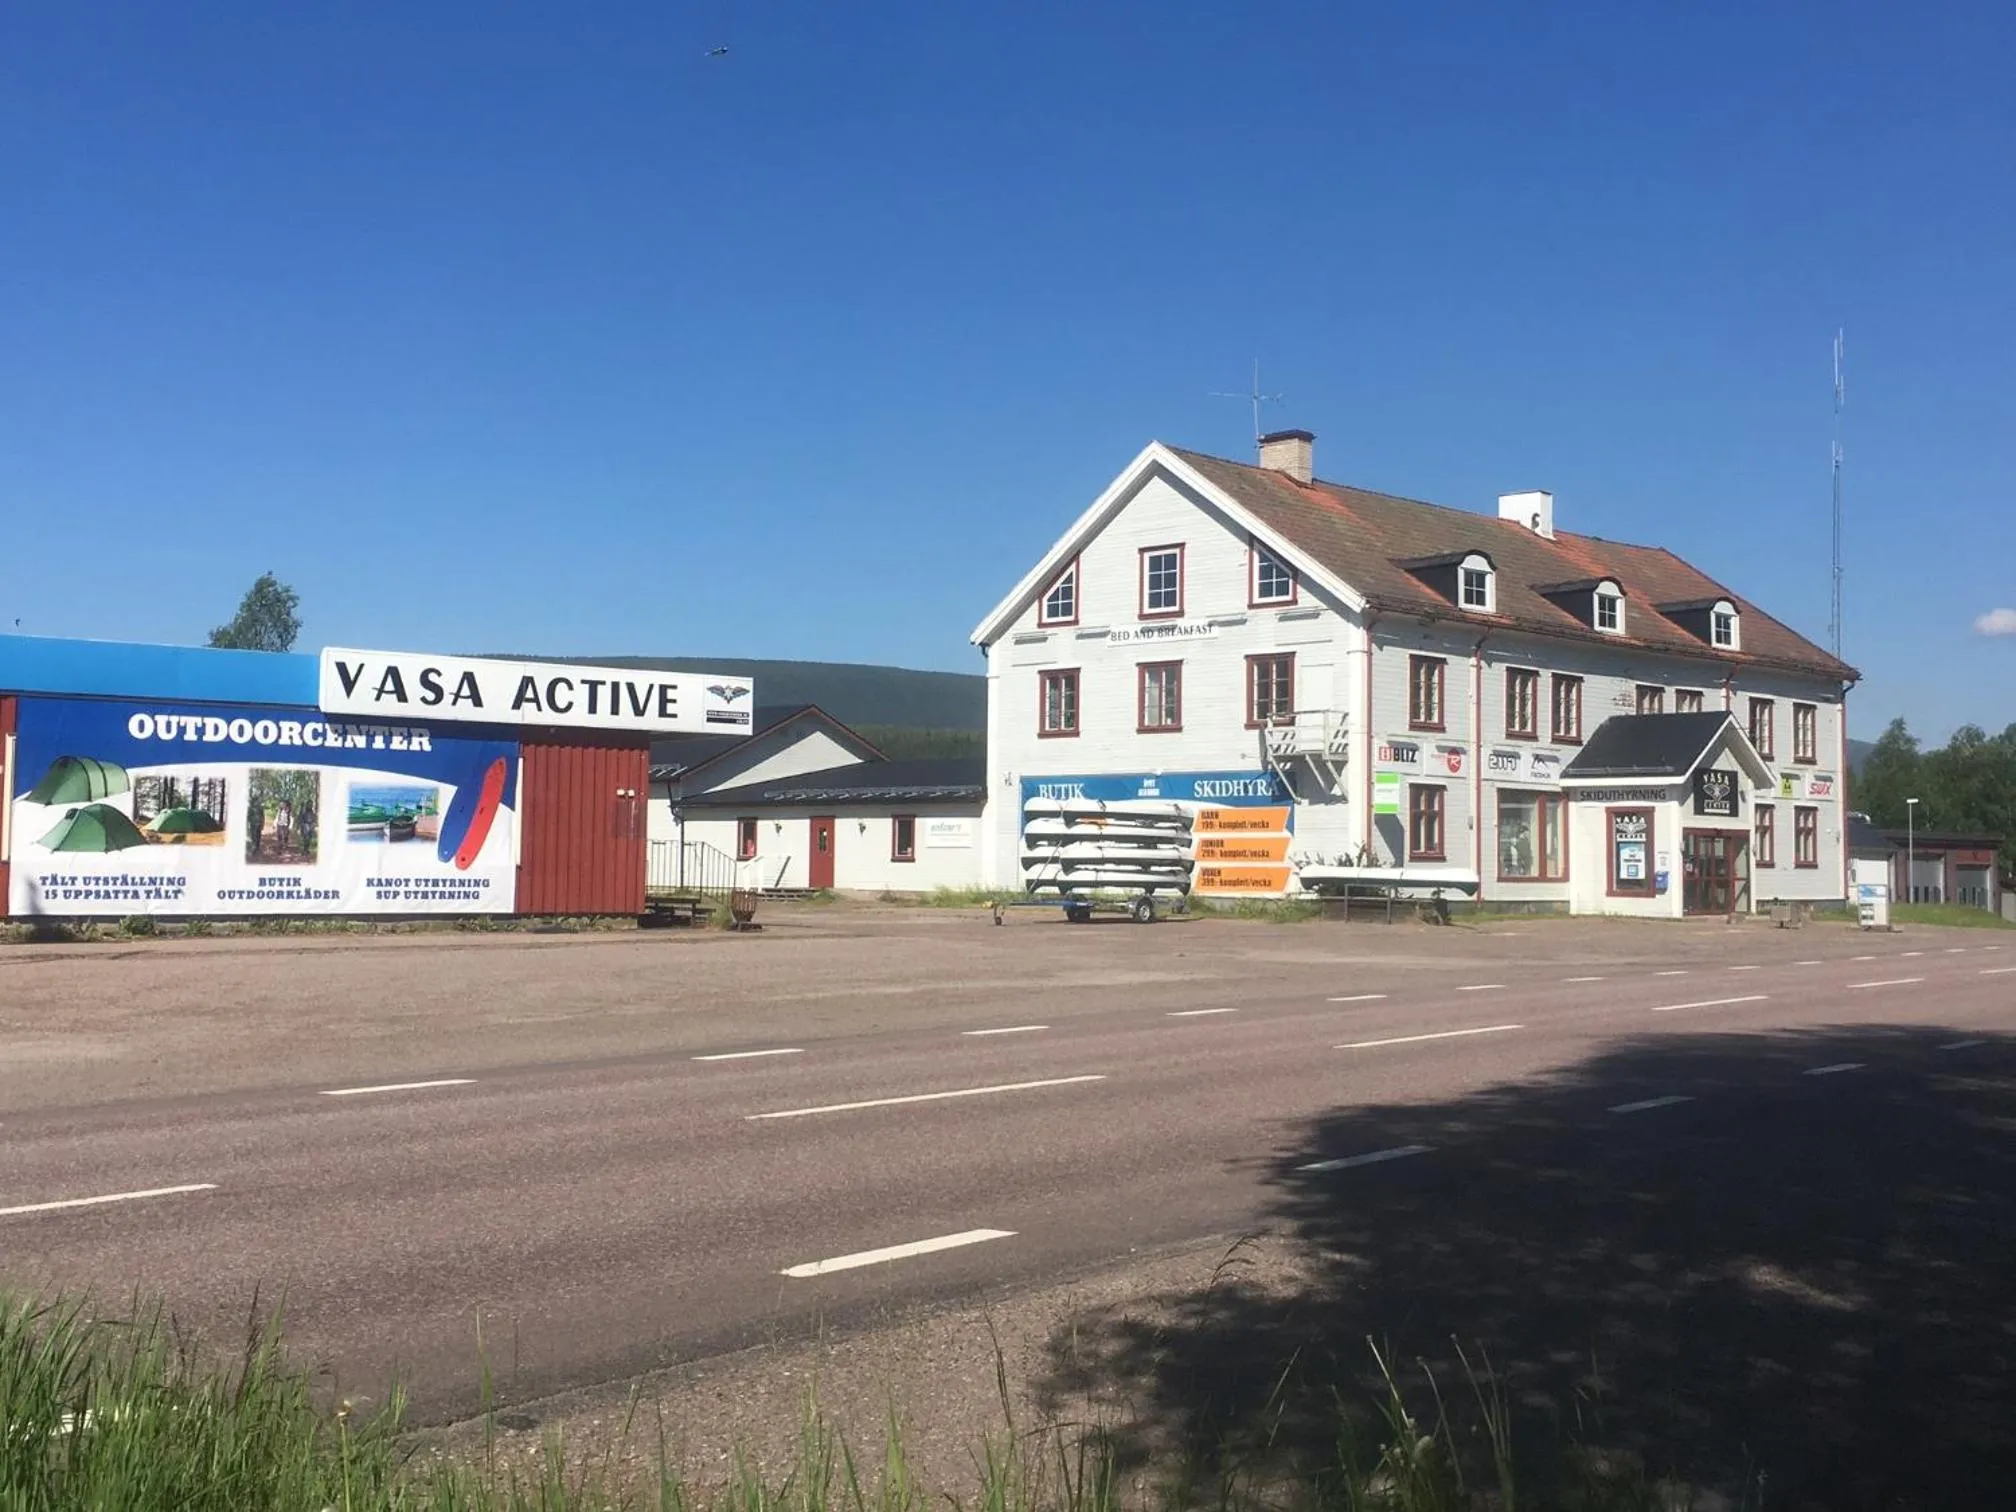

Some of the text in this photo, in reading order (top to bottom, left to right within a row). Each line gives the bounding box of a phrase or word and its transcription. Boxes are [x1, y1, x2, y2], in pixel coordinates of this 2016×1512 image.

[1110, 624, 1214, 641] BED AND BREAKFAST
[335, 661, 679, 719] VASA ACTIVE
[128, 713, 432, 752] OUTDOORCENTER
[1393, 747, 1417, 763] BLIZ
[1703, 772, 1729, 785] VASA
[1039, 783, 1085, 801] BUTIK
[1579, 788, 1667, 801] SKIDUTHYRNING
[39, 873, 187, 886] TÄLT UTSTÄLLNING
[258, 877, 302, 887] BUTIK
[366, 878, 490, 888] KANOT UTHYRNING
[44, 887, 181, 900] 15 UPPSATTA TÄLT
[217, 887, 340, 900] OUTDOORKLÄDER
[376, 890, 480, 900] SUP UTHYRNING
